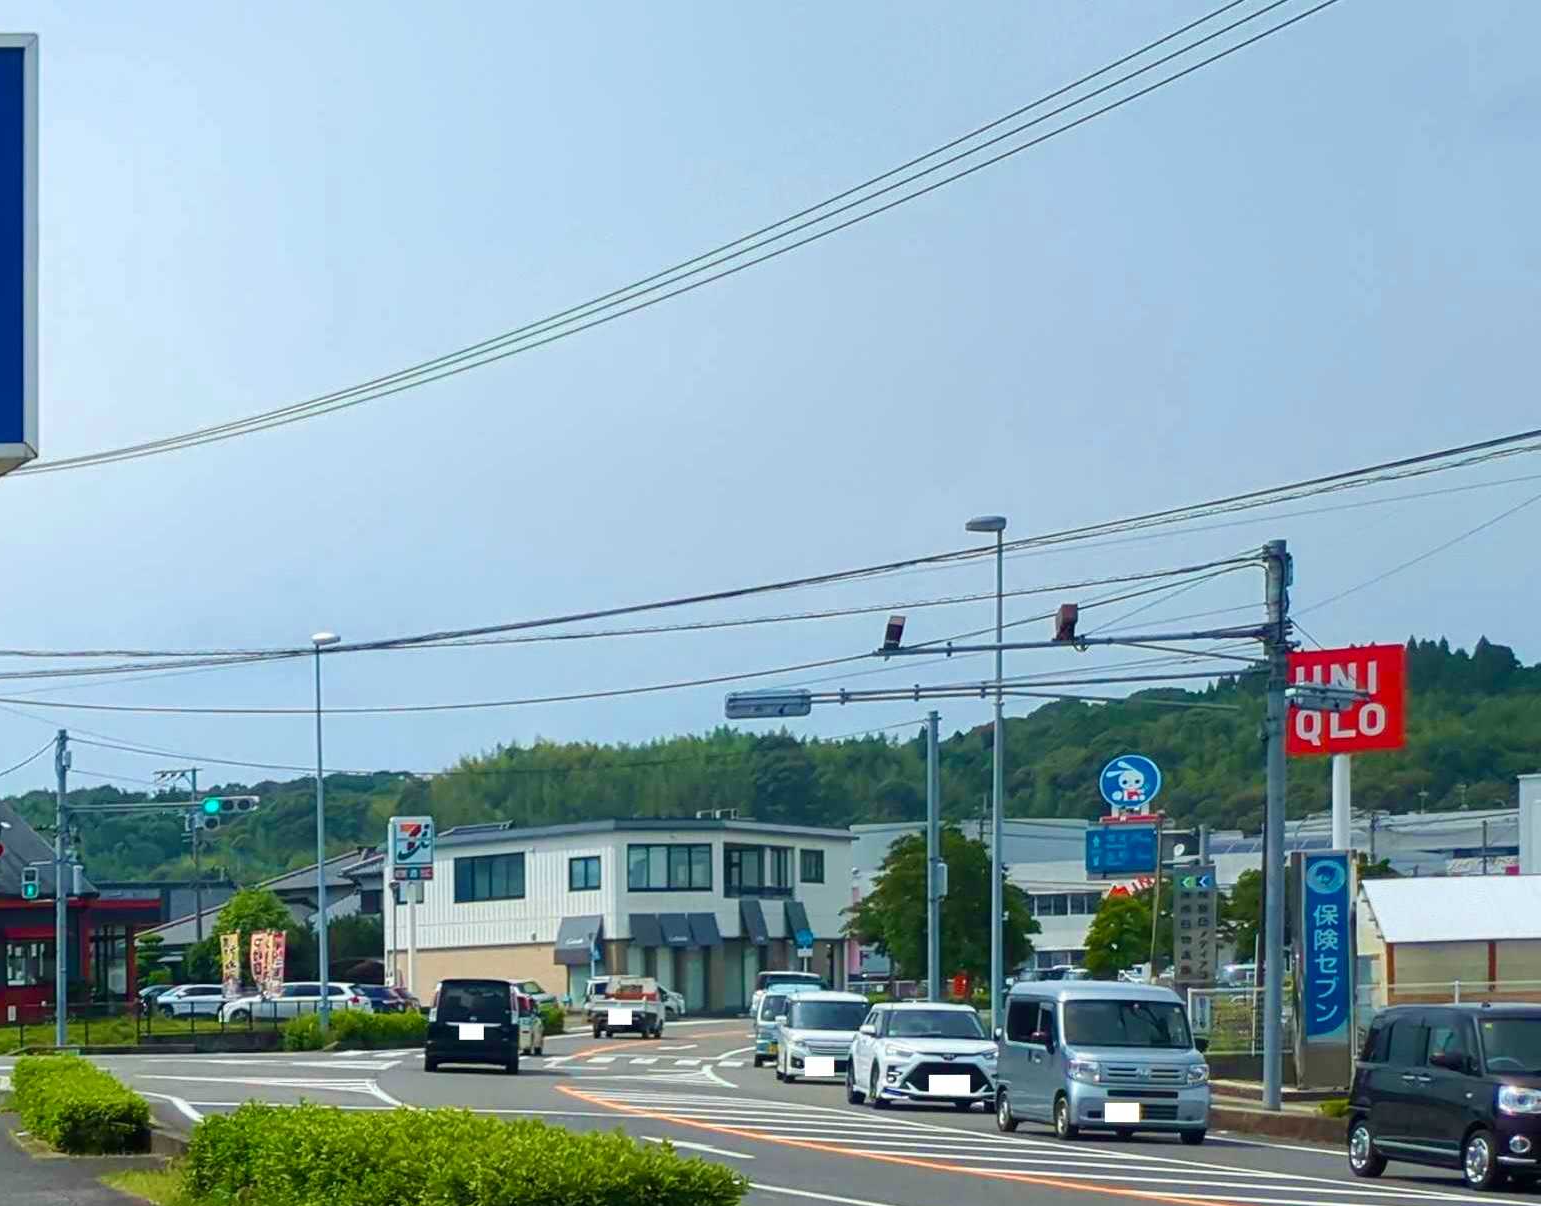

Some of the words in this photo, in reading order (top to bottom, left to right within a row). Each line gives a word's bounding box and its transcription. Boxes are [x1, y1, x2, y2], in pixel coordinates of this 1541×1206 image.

[1295, 702, 1386, 747] QLO
[1312, 904, 1340, 1022] 保険セブン
